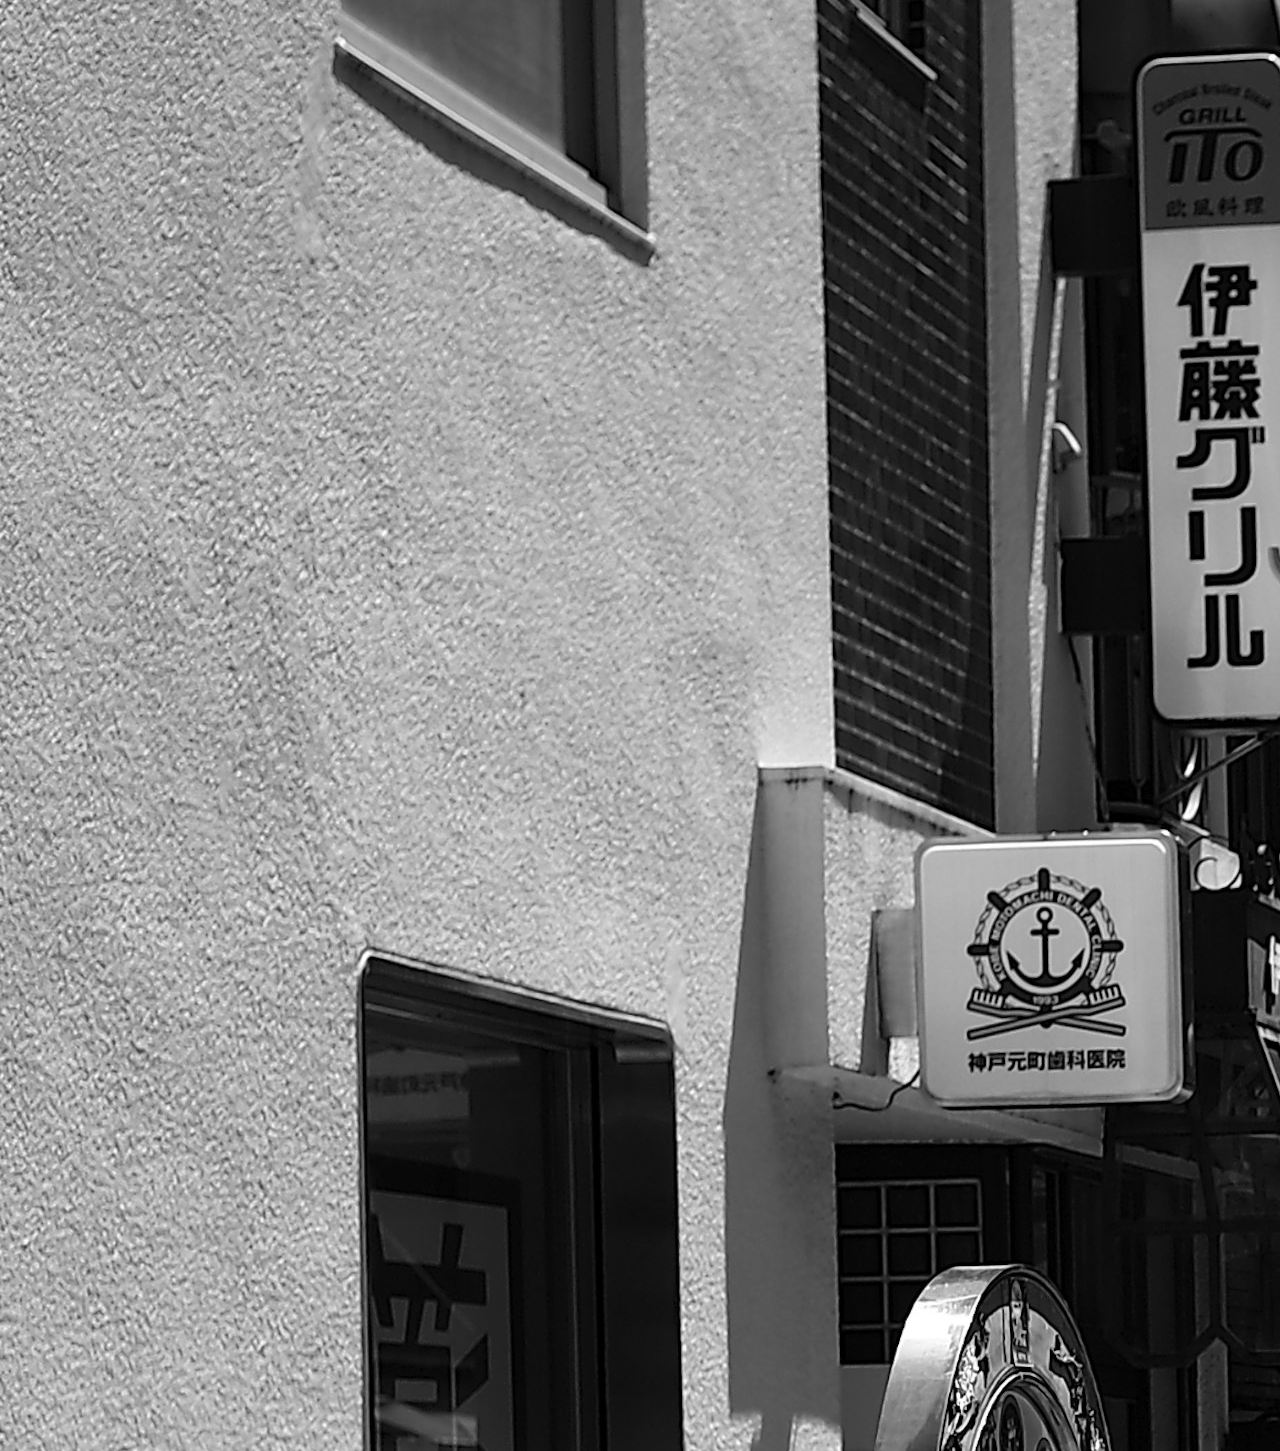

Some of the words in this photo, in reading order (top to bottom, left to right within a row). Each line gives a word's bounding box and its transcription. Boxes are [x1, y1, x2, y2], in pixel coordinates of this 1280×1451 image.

[1179, 107, 1247, 125] GRILL
[1176, 261, 1266, 671] 伊藤グリル
[1057, 893, 1097, 933] DENTAL
[968, 1049, 1127, 1073] 神戸元町歯科医院
